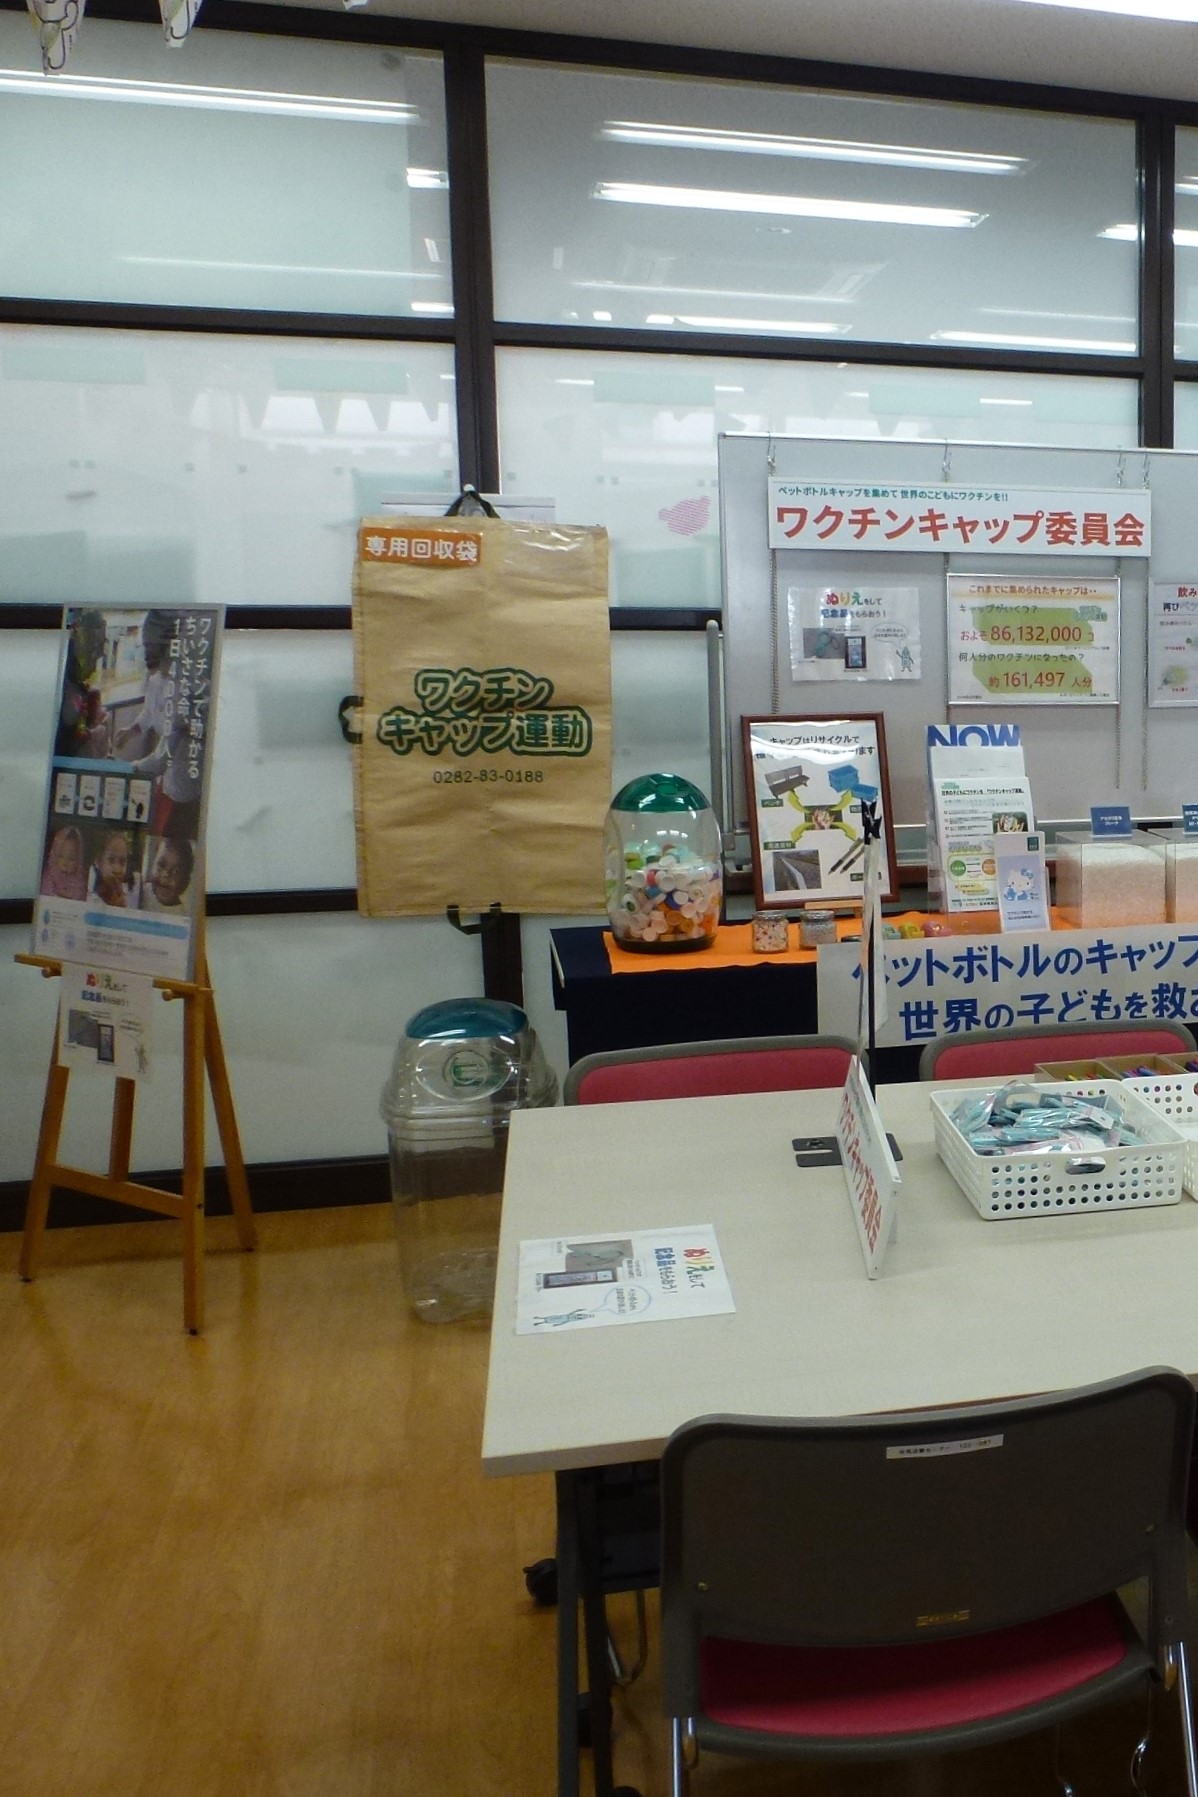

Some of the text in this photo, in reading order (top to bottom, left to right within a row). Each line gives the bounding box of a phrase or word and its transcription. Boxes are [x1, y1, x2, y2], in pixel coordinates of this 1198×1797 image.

[778, 487, 898, 498] ペットボトルキャップを集めて
[776, 504, 1145, 546] ワクチンキャップ委員会
[365, 535, 478, 562] 専用回収袋
[826, 592, 882, 606] ぬりえをして
[960, 631, 988, 641] およそ
[990, 625, 1082, 643] 86,132,000
[959, 652, 1085, 662] 何人分のワクチンになったの？
[1003, 672, 1065, 690] 161,497
[1071, 677, 1093, 688] 人分
[415, 668, 554, 715] ワクチン
[378, 707, 592, 756] キャップ運動
[927, 724, 1021, 746] NOW
[433, 769, 544, 784] 0282-83-0188
